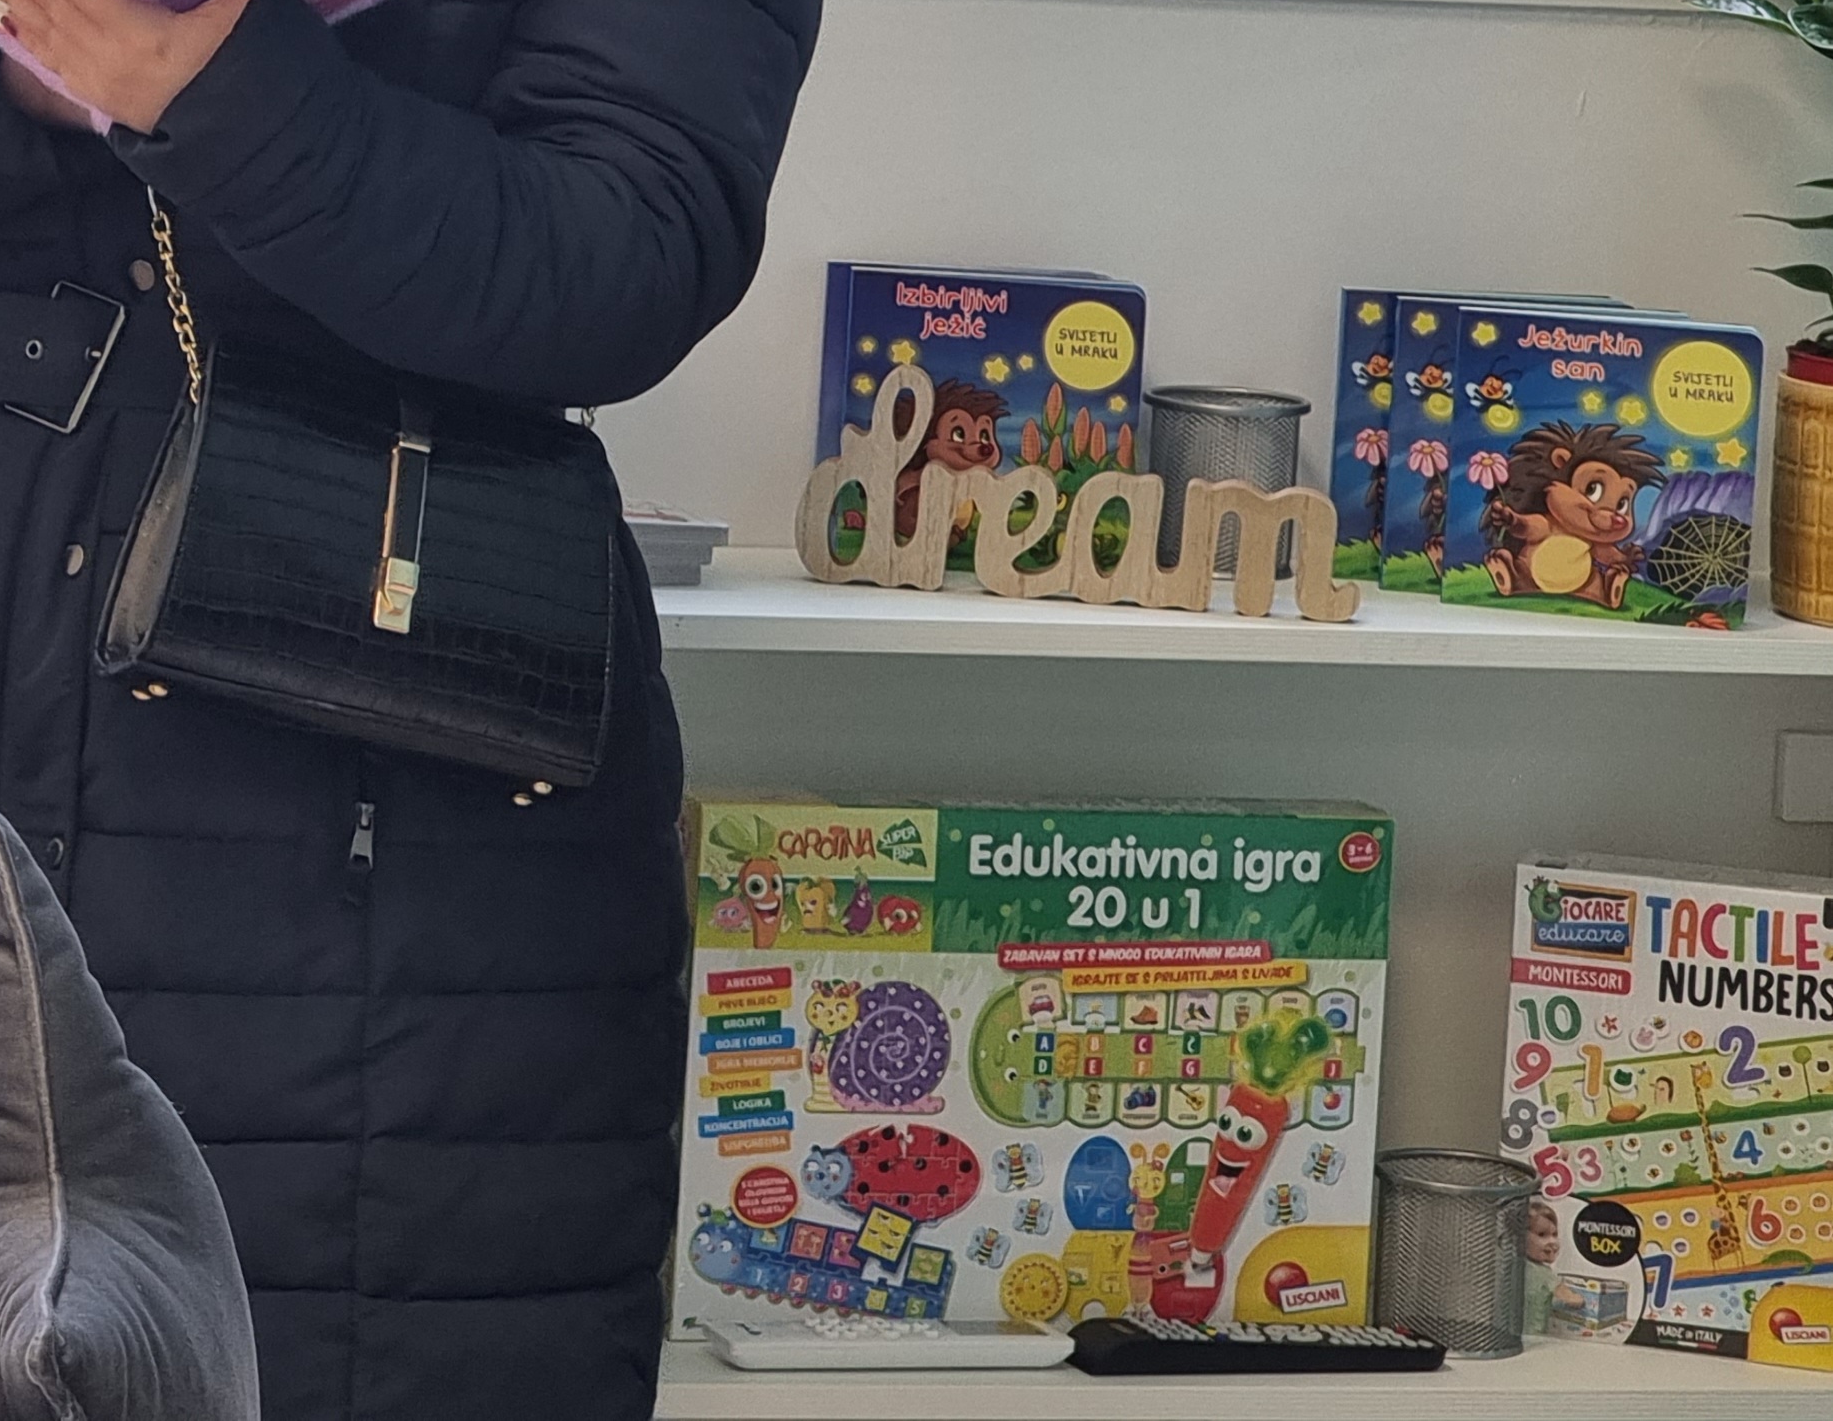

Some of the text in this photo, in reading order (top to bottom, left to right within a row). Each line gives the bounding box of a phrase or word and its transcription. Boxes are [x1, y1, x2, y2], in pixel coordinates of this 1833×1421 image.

[896, 281, 1009, 314] Izbirljivi
[1055, 343, 1119, 360] U MRAKU
[1058, 327, 1117, 343] SVIJETLI
[1518, 323, 1643, 358] Ježurkin
[1551, 358, 1606, 382] san
[1673, 370, 1734, 388] SVIJETLI
[1669, 386, 1734, 404] U MRAKU
[795, 364, 1359, 622] dream
[778, 824, 876, 861] CAROTINA
[969, 832, 1322, 892] Edukativna igra
[1067, 885, 1201, 929] 20 u 1
[1537, 923, 1625, 943] educare
[1646, 895, 1820, 971] TACTILE
[1003, 949, 1060, 963] ZABAVAN
[1062, 949, 1085, 962] SET
[1144, 947, 1221, 960] EDUKATIVNIH
[1224, 946, 1261, 958] IGARA
[1072, 972, 1120, 986] IGRAJTE
[1528, 964, 1623, 991] MONTESSORI
[1658, 959, 1833, 1022] NUMBERS
[1518, 994, 1582, 1041] 10
[1039, 1037, 1049, 1049] A
[1719, 1025, 1766, 1084] 2
[1038, 1059, 1048, 1071] D
[1088, 1059, 1097, 1070] E
[1185, 1062, 1195, 1071] G
[1513, 1041, 1553, 1090] 9
[1579, 1043, 1604, 1098] 1
[1500, 1098, 1539, 1151] 8
[1732, 1129, 1764, 1166] 4
[1532, 1145, 1574, 1197] 5
[1576, 1147, 1602, 1183] 3
[1577, 1220, 1637, 1239] MONTESSORI
[1750, 1198, 1784, 1243] 6
[1590, 1235, 1622, 1255] BOX
[793, 1277, 804, 1291] 2
[833, 1284, 843, 1299] 3
[1285, 1287, 1340, 1308] LISCIANI
[1643, 1253, 1673, 1309] 7
[1656, 1326, 1684, 1339] MADE
[1694, 1329, 1723, 1343] ITALY
